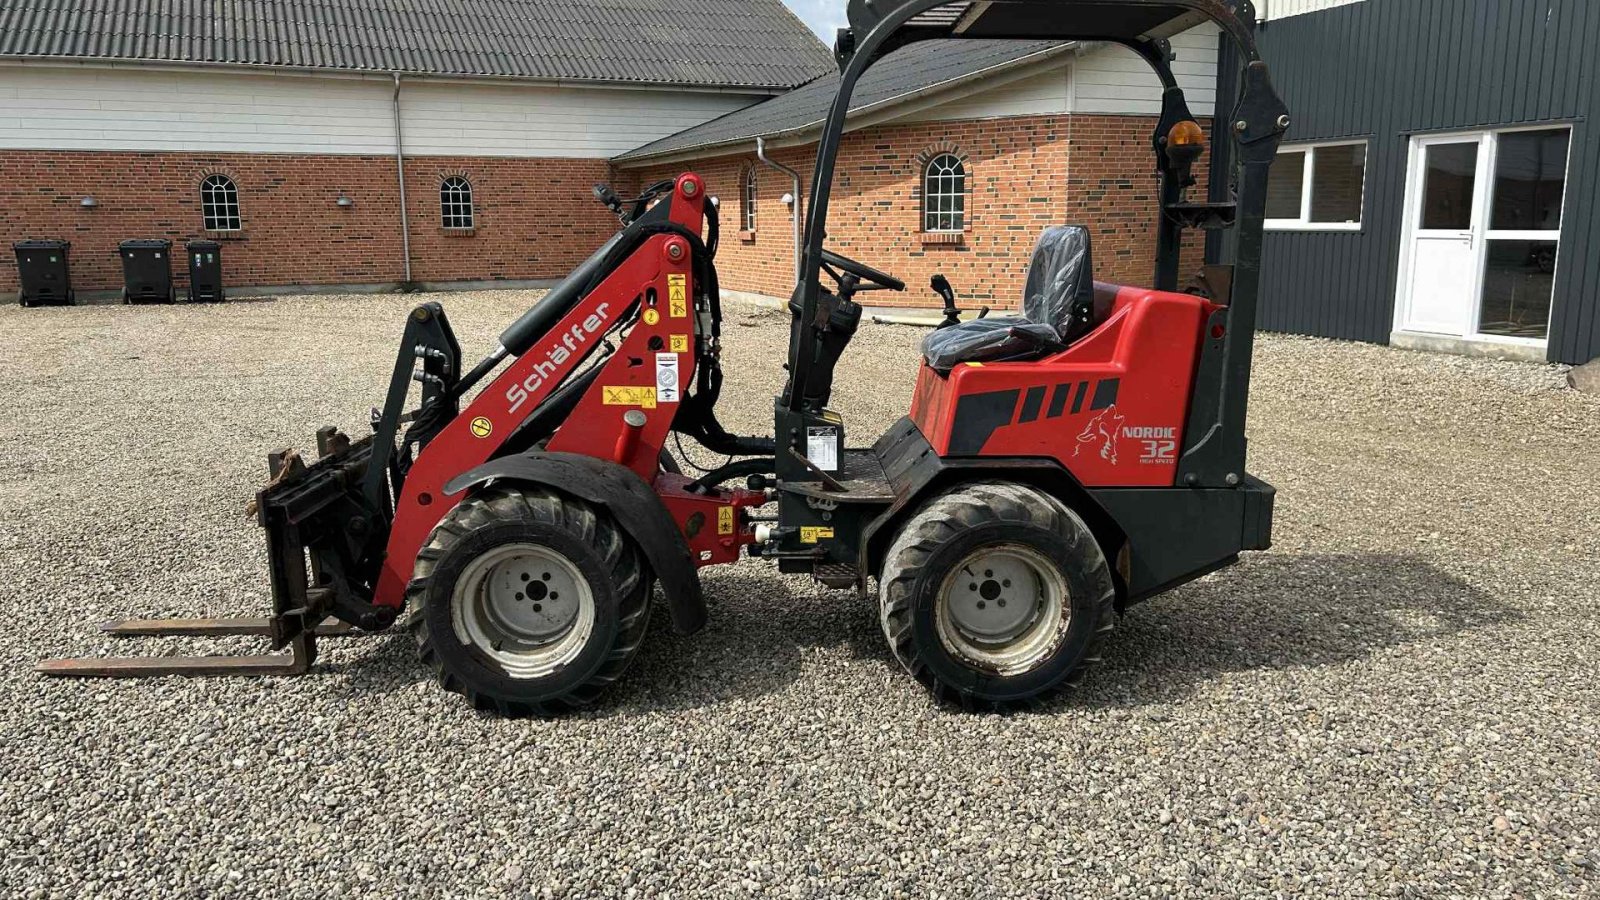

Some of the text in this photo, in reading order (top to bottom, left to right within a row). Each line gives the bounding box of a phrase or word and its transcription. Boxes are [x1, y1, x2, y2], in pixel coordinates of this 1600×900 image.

[506, 302, 609, 414] Schäffer
[1122, 426, 1177, 438] NORDIC
[1140, 440, 1175, 458] 32
